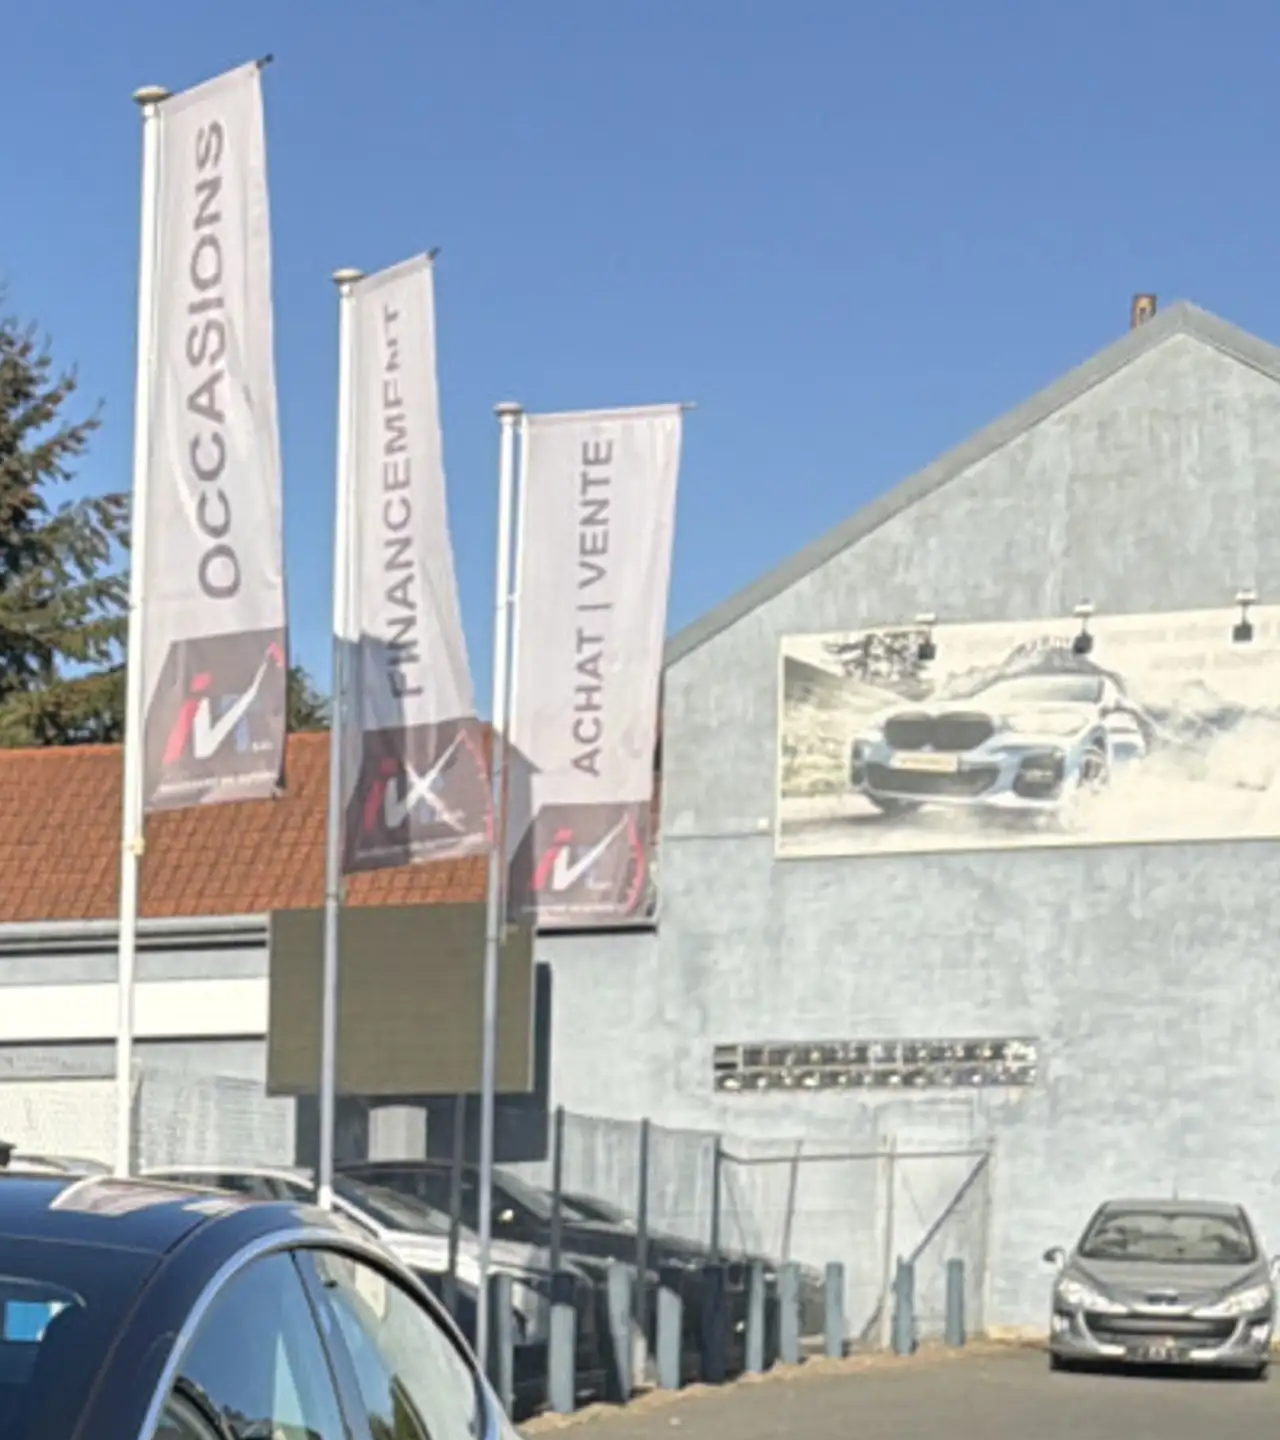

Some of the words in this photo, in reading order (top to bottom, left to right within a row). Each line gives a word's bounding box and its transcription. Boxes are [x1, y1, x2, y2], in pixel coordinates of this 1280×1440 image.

[186, 119, 242, 599] OCCASIONS
[577, 438, 614, 590] VENTE
[571, 628, 605, 778] ACHAT
